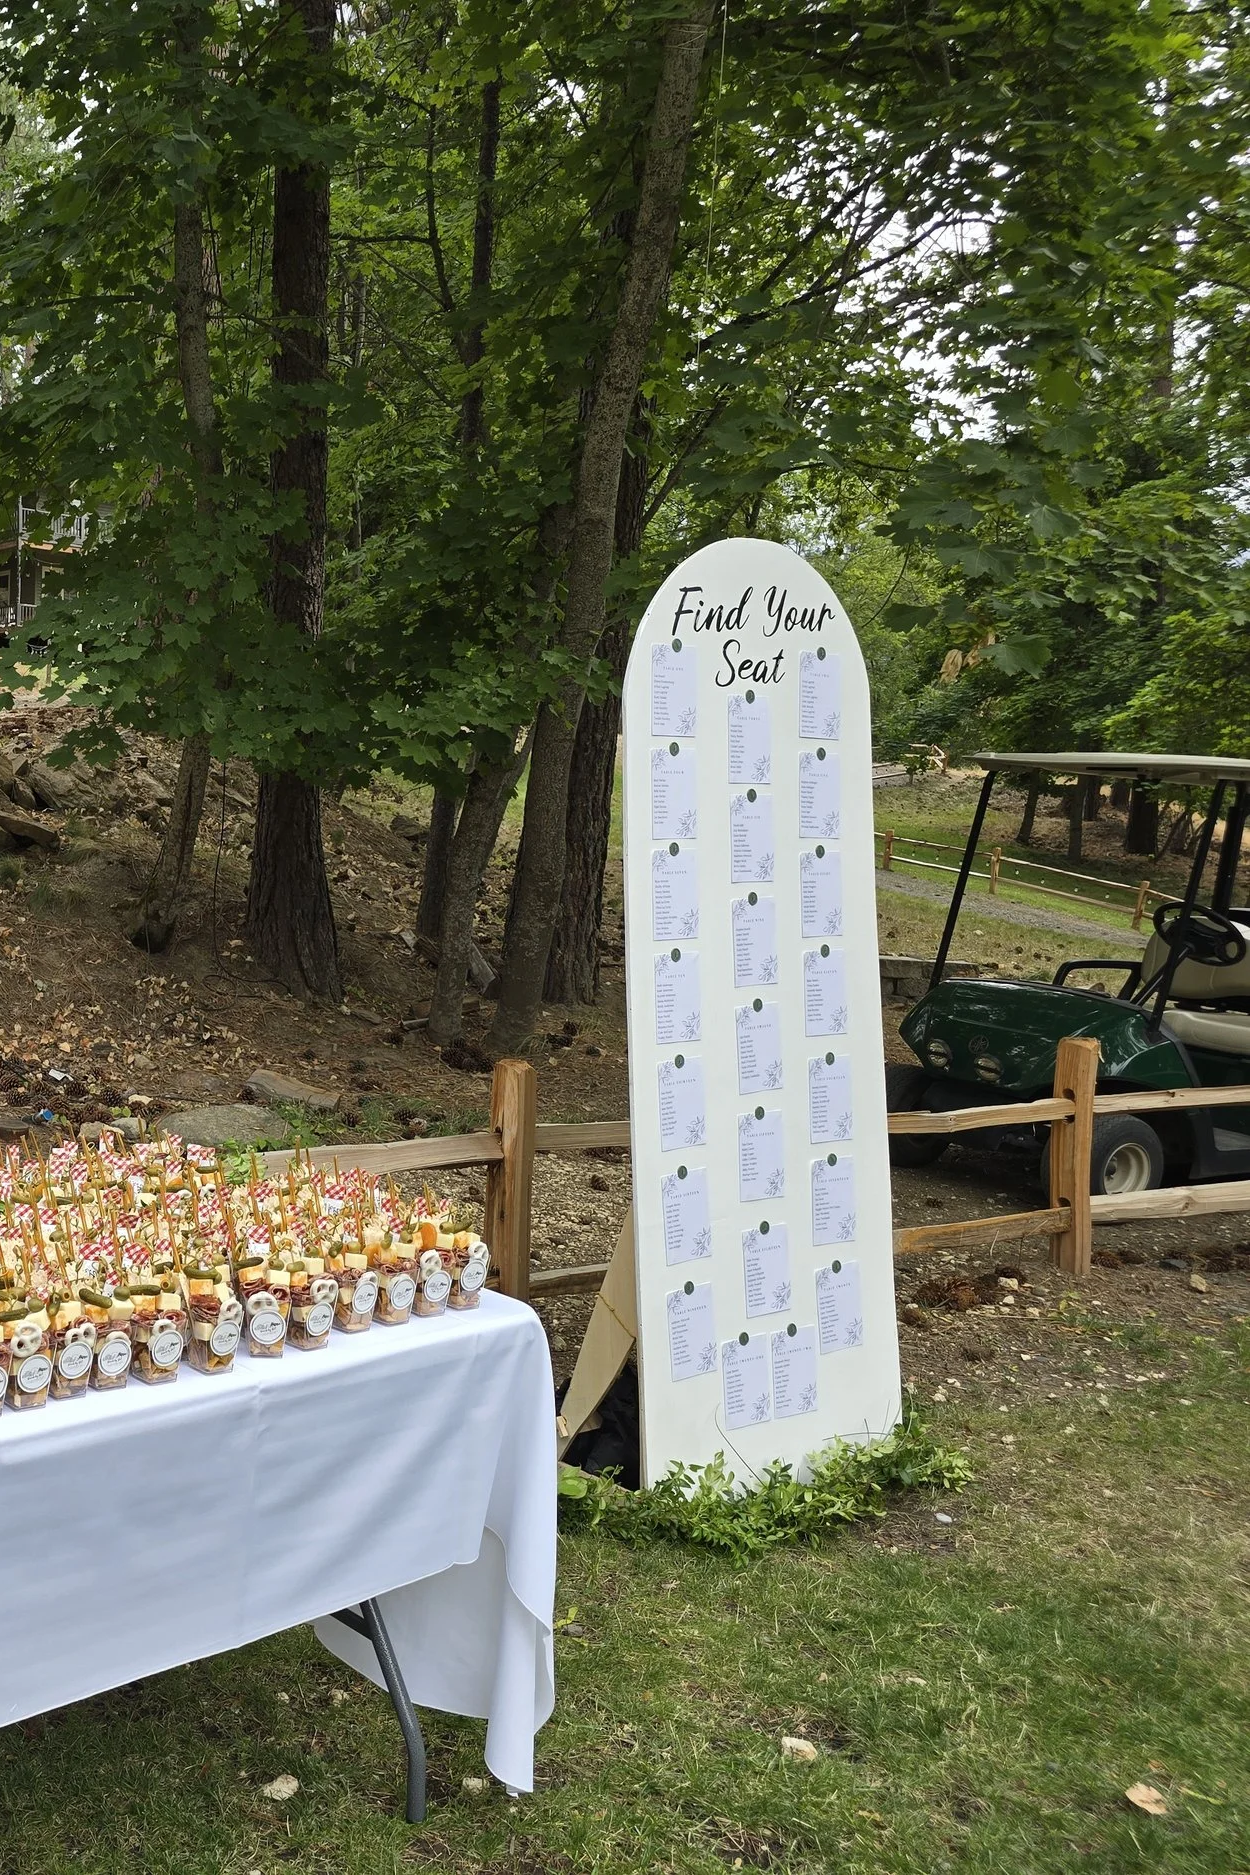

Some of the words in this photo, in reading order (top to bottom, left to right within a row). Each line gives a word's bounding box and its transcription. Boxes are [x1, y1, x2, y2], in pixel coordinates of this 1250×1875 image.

[671, 586, 753, 636] Find
[762, 585, 835, 637] Your
[715, 639, 786, 687] Seat
